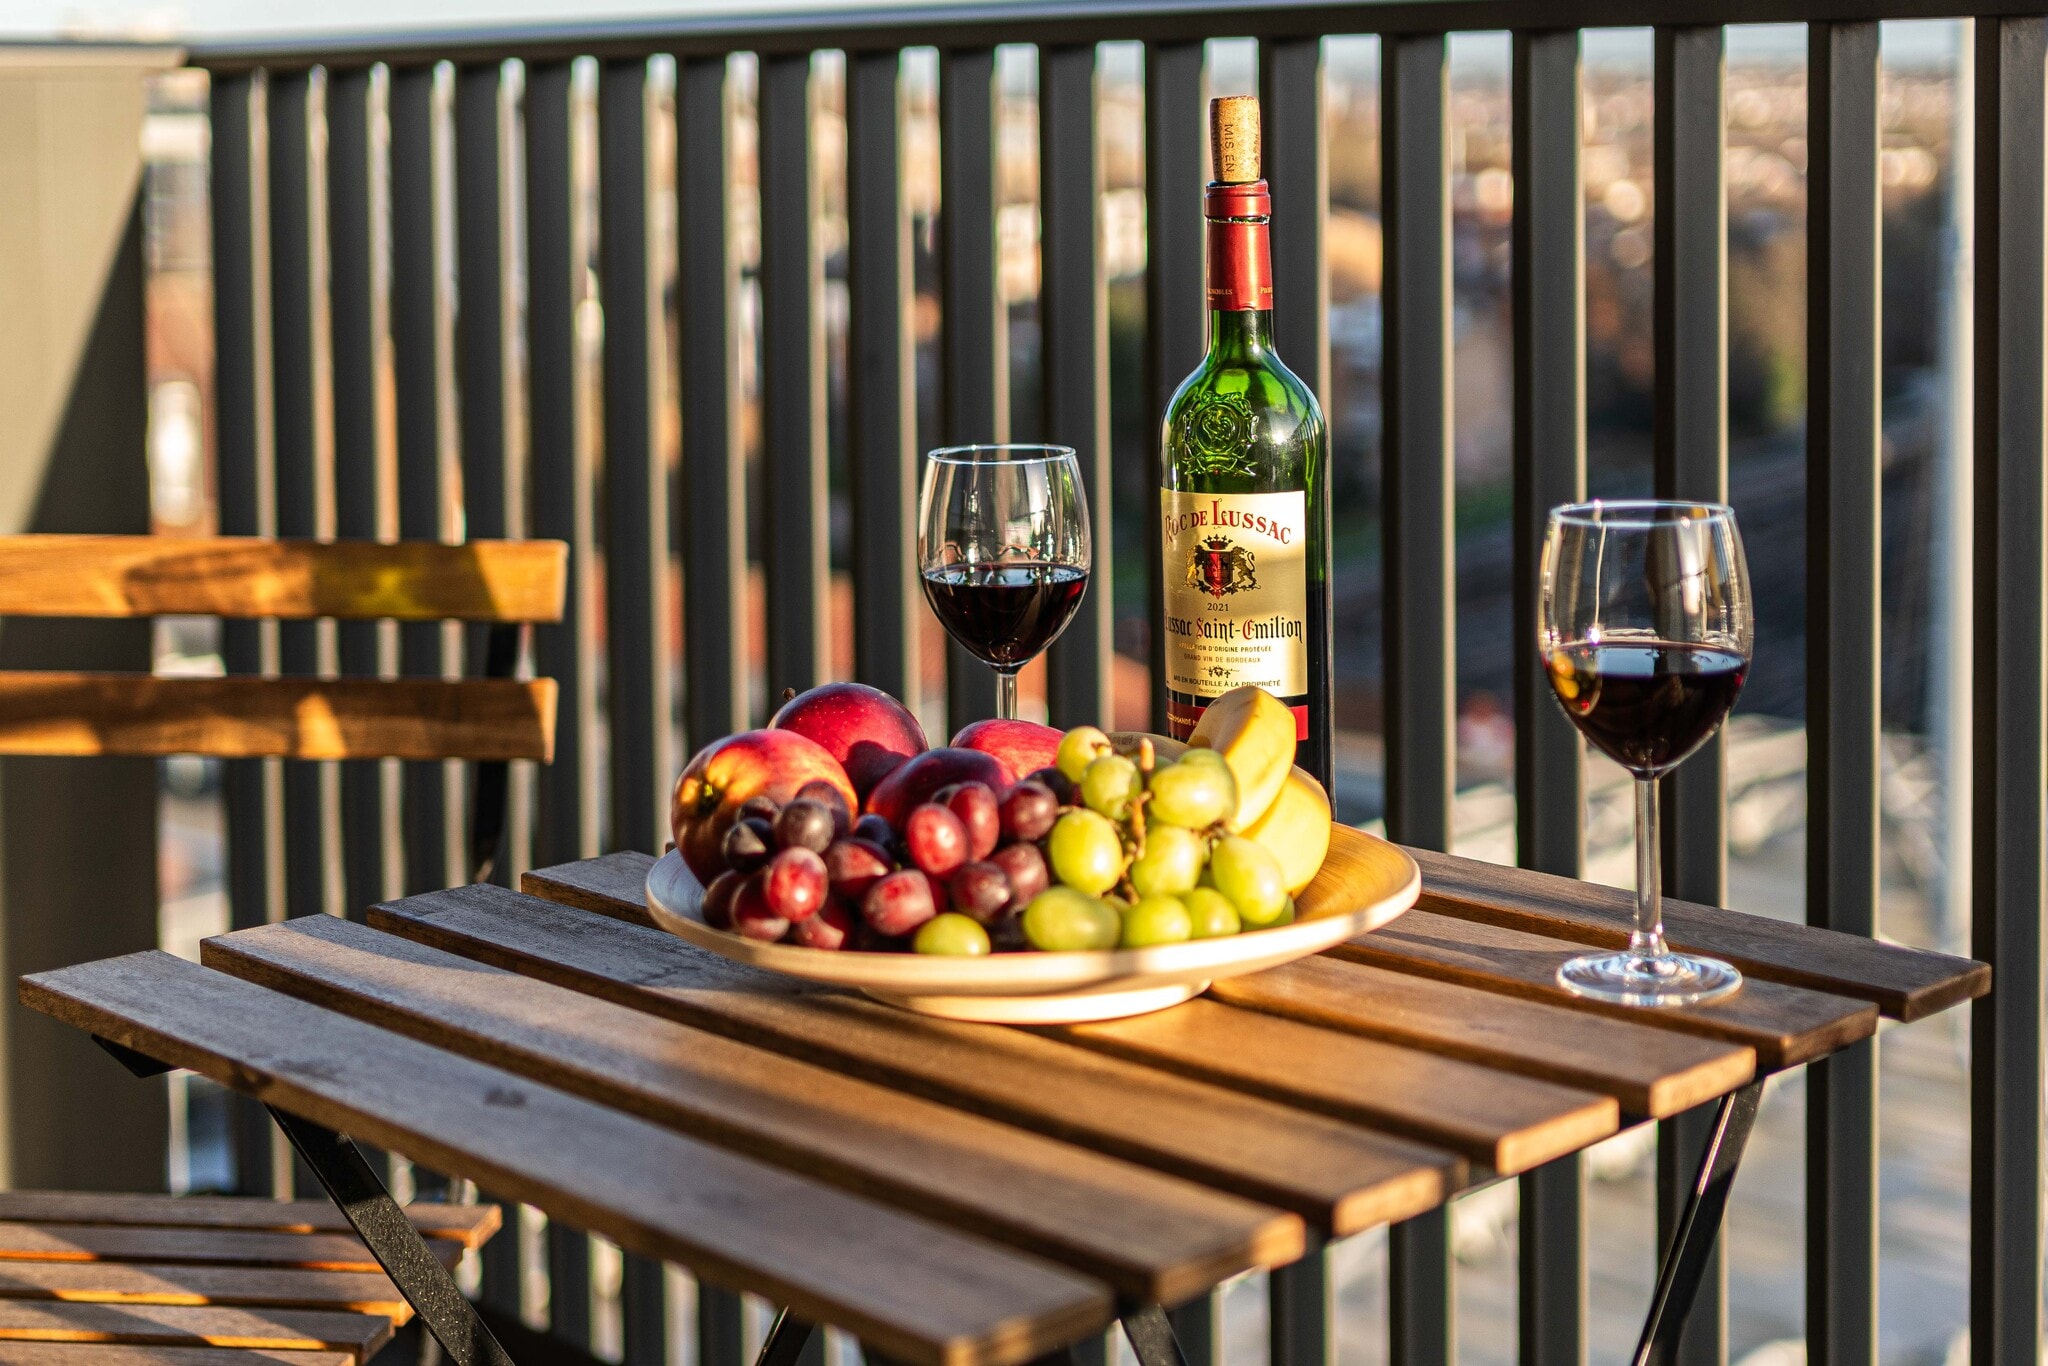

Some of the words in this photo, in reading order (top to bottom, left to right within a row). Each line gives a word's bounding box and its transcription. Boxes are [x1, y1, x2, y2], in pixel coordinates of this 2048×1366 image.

[1224, 124, 1234, 149] MIS
[1225, 155, 1235, 172] EN
[1190, 510, 1208, 528] DE
[1212, 498, 1291, 545] LUSSAC
[1207, 602, 1229, 612] 2021
[1184, 652, 1201, 661] GRAND
[1181, 676, 1188, 684] EN
[1188, 678, 1222, 687] BOUTEILLE
